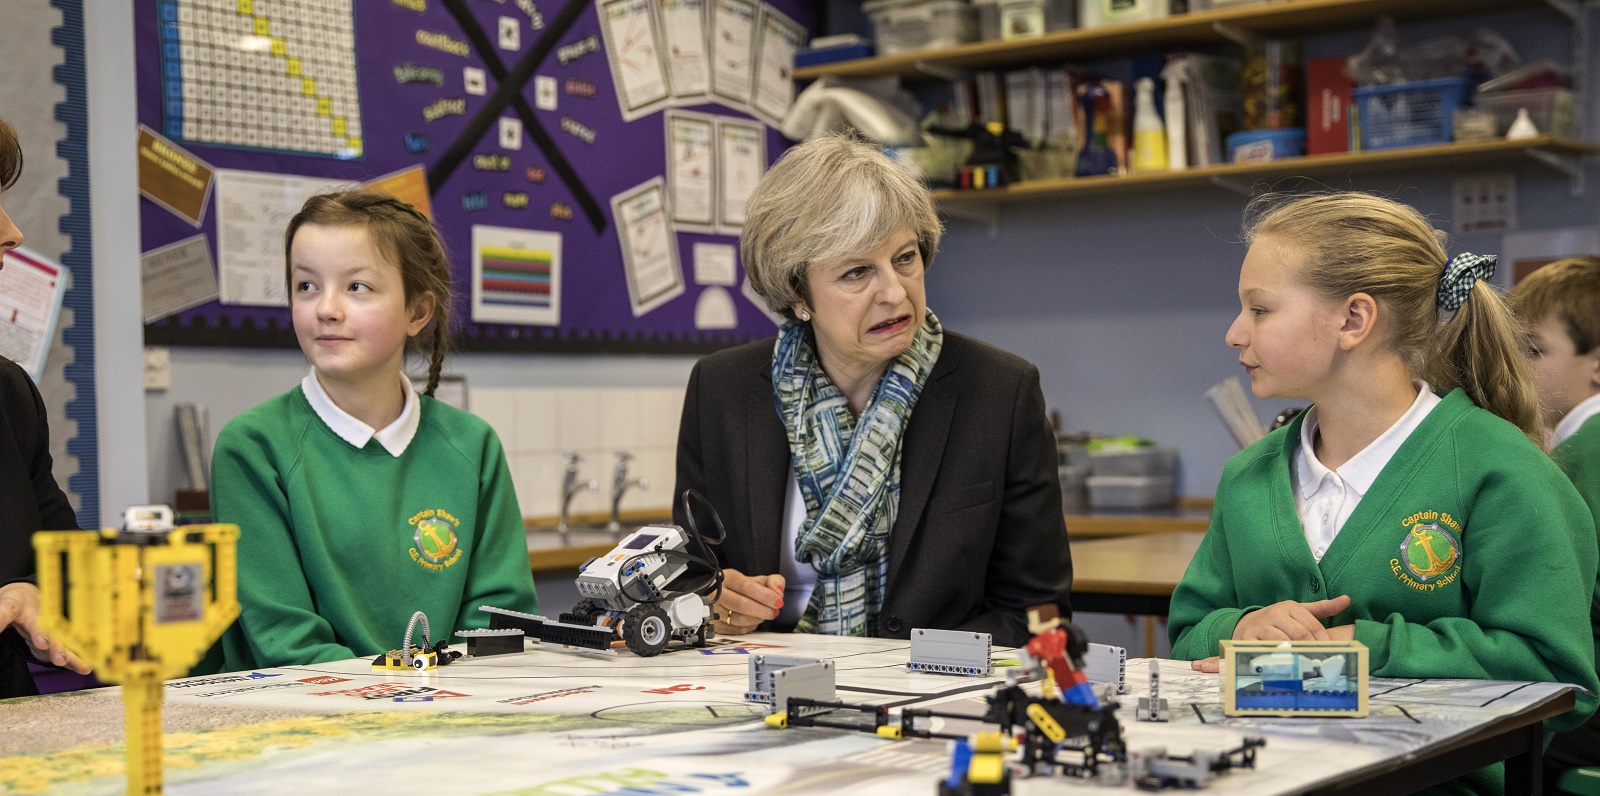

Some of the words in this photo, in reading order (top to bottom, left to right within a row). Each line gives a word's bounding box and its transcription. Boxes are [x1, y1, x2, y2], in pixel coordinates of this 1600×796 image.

[408, 509, 434, 525] Captain
[436, 509, 460, 527] Shaw's
[1402, 510, 1437, 527] Captain
[417, 558, 443, 571] Primary
[444, 549, 462, 567] School
[1389, 558, 1403, 576] C.E.
[1398, 573, 1435, 591] Primary
[1436, 565, 1462, 588] School
